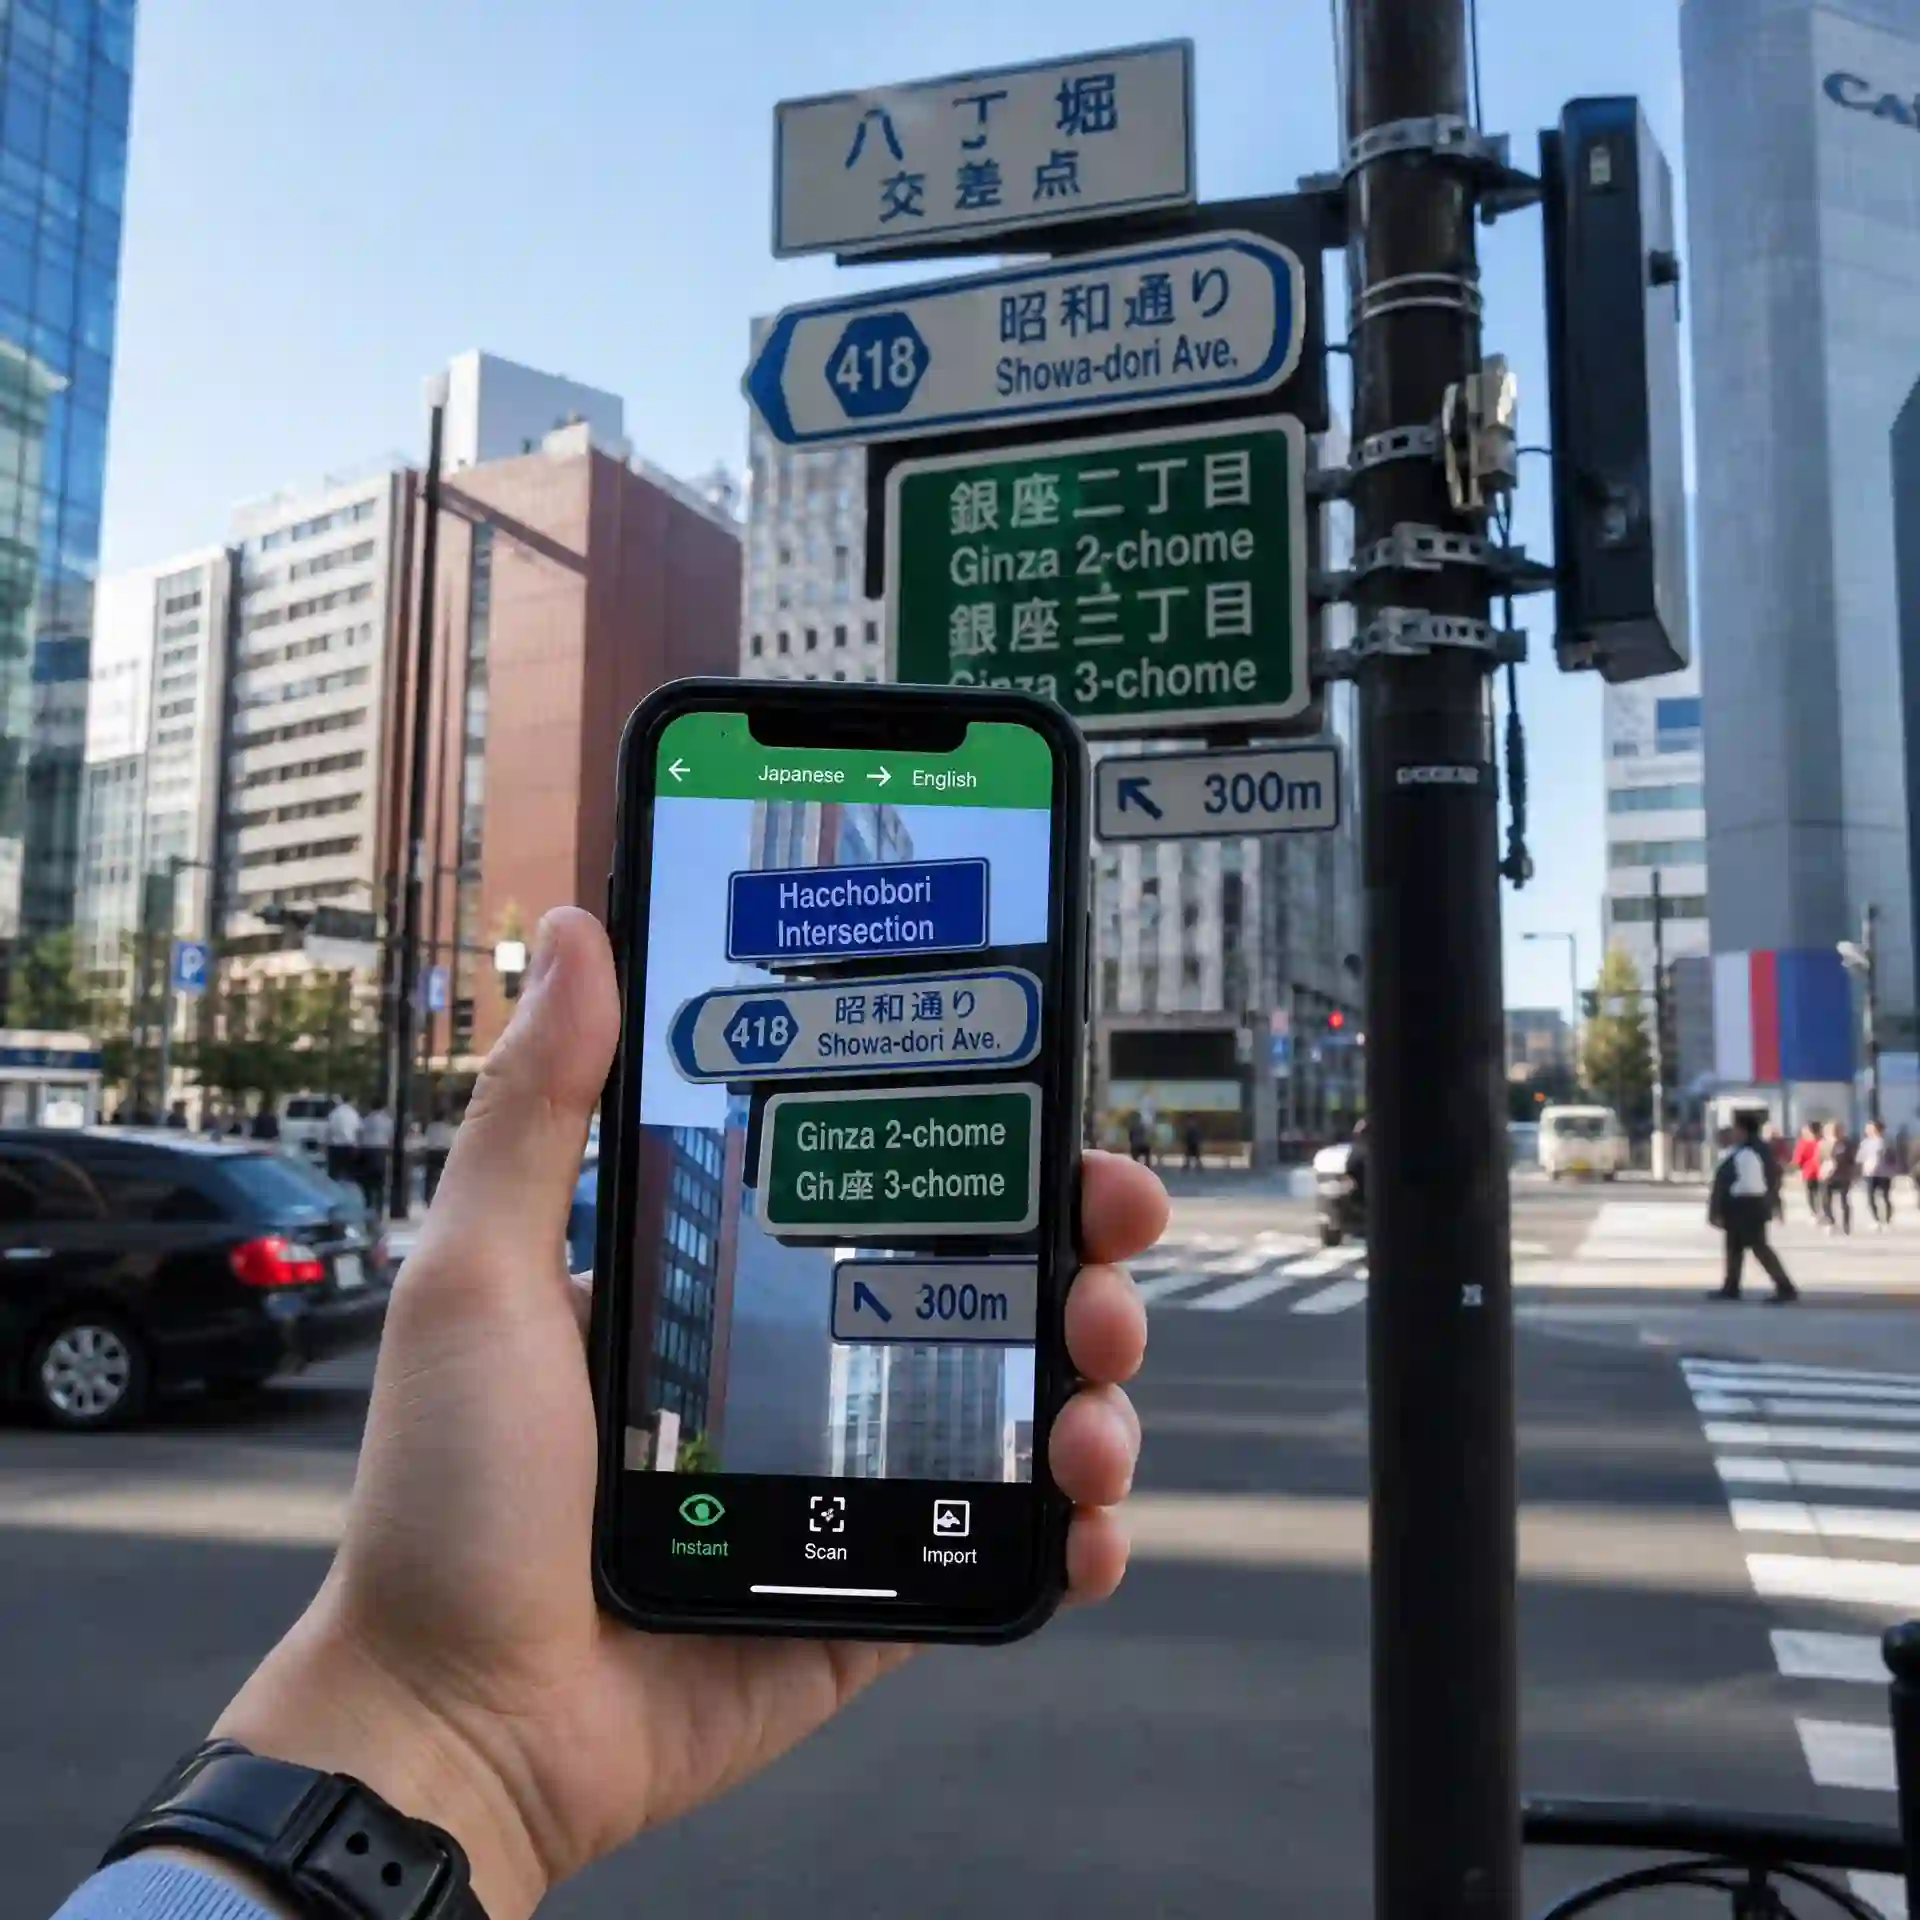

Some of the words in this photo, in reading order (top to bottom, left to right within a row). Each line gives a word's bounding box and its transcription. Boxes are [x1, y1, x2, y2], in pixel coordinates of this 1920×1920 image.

[845, 73, 1119, 169] 八丁堀
[1822, 71, 1920, 134] Ca
[879, 149, 1082, 223] 交差点
[1001, 267, 1230, 344] 昭和通り
[835, 337, 917, 393] 418
[997, 337, 1160, 396] Showa-dori
[1172, 334, 1238, 373] Ave.
[950, 451, 1250, 536] 銀座二丁目
[950, 544, 1059, 587] Ginza
[1075, 528, 1254, 575] 2-chome
[949, 581, 1252, 658] 銀座三丁目
[1074, 656, 1257, 702] 3-chome
[758, 765, 845, 784] Japanese
[912, 769, 977, 790] English
[1204, 771, 1322, 815] 300m
[779, 876, 931, 909] Hacchobori
[778, 914, 934, 948] Intersection
[835, 990, 975, 1025] 昭和通り
[731, 1015, 789, 1048] 418
[817, 1027, 943, 1057] Showa-dori
[951, 1027, 1000, 1051] Ave.
[797, 1121, 875, 1151] Ginza
[885, 1118, 1006, 1148] 2-chome
[884, 1168, 1005, 1198] 3-chome
[915, 1283, 1007, 1322] 300m
[671, 1538, 729, 1557] Instant
[804, 1543, 847, 1561] Scan
[923, 1546, 978, 1567] Import
